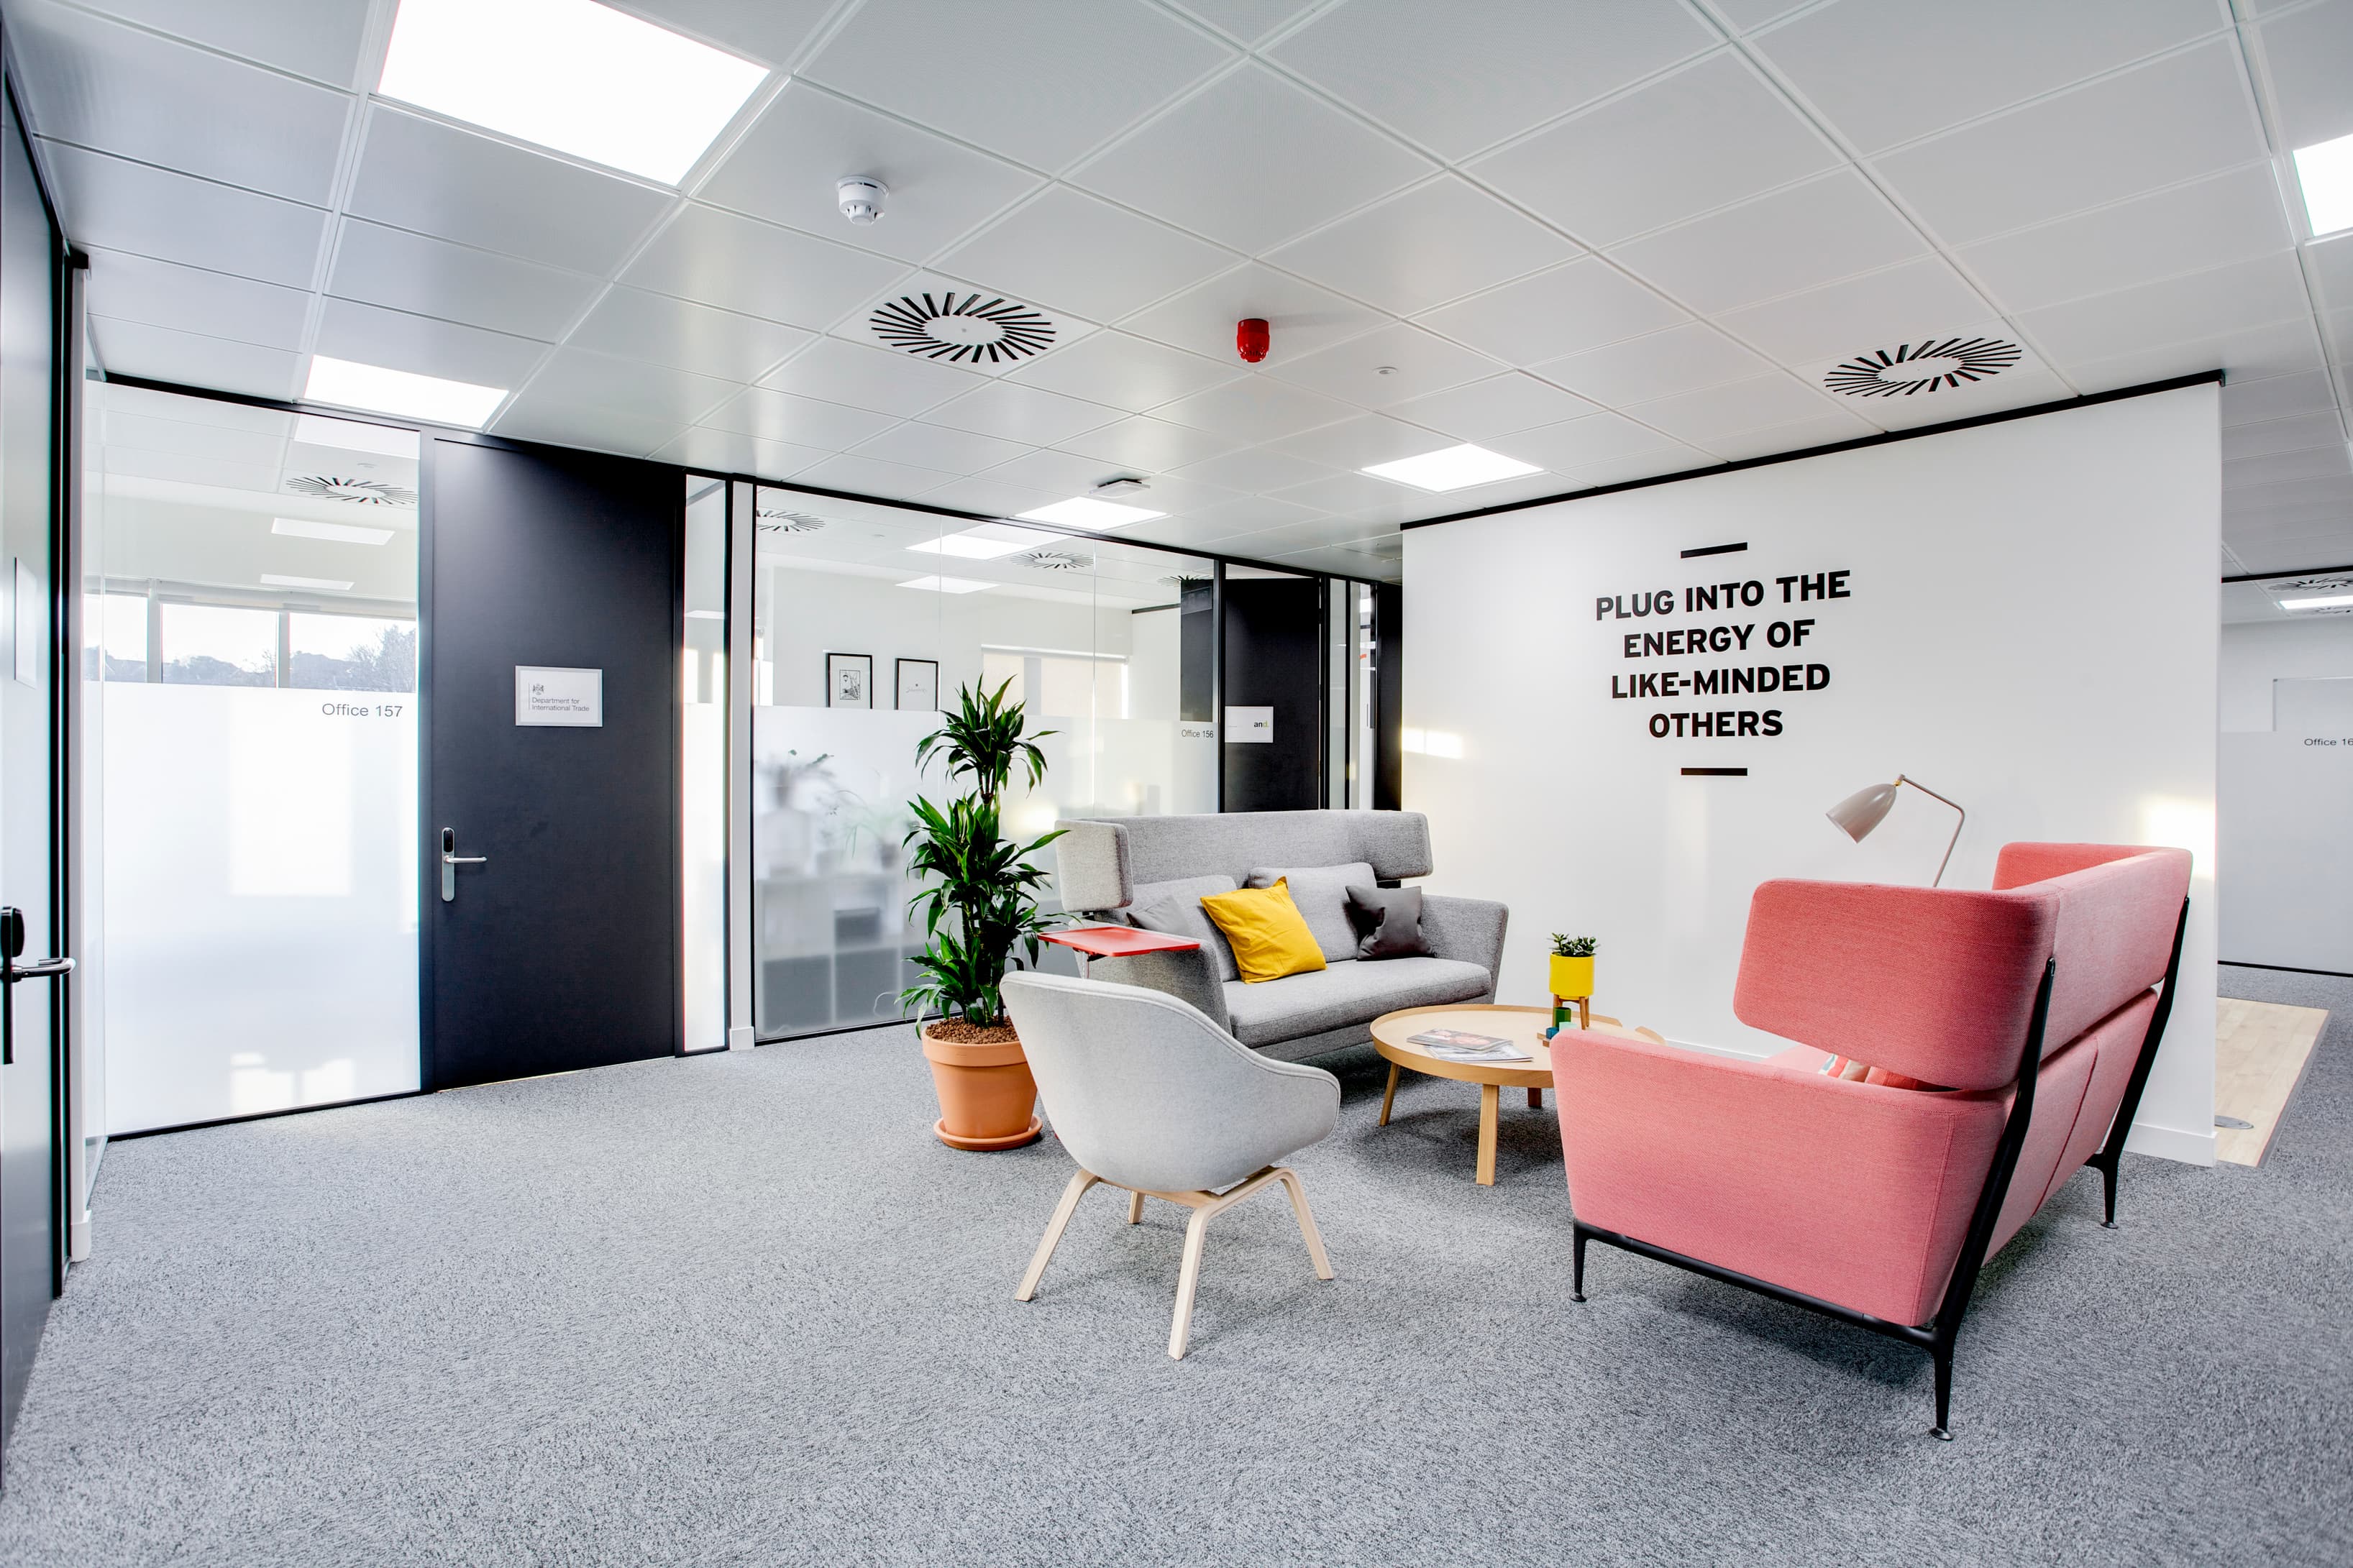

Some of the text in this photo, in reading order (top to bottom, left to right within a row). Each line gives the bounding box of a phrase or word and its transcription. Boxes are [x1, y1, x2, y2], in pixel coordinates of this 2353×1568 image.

[1596, 569, 1851, 621] PLUG INTO THE
[1624, 618, 1815, 659] ENERGY OF
[1612, 663, 1830, 699] LIKE-MINDED
[321, 703, 403, 717] Office 157
[1649, 710, 1783, 738] OTHERS
[1181, 729, 1214, 738] Office 156
[2303, 738, 2337, 746] Office
